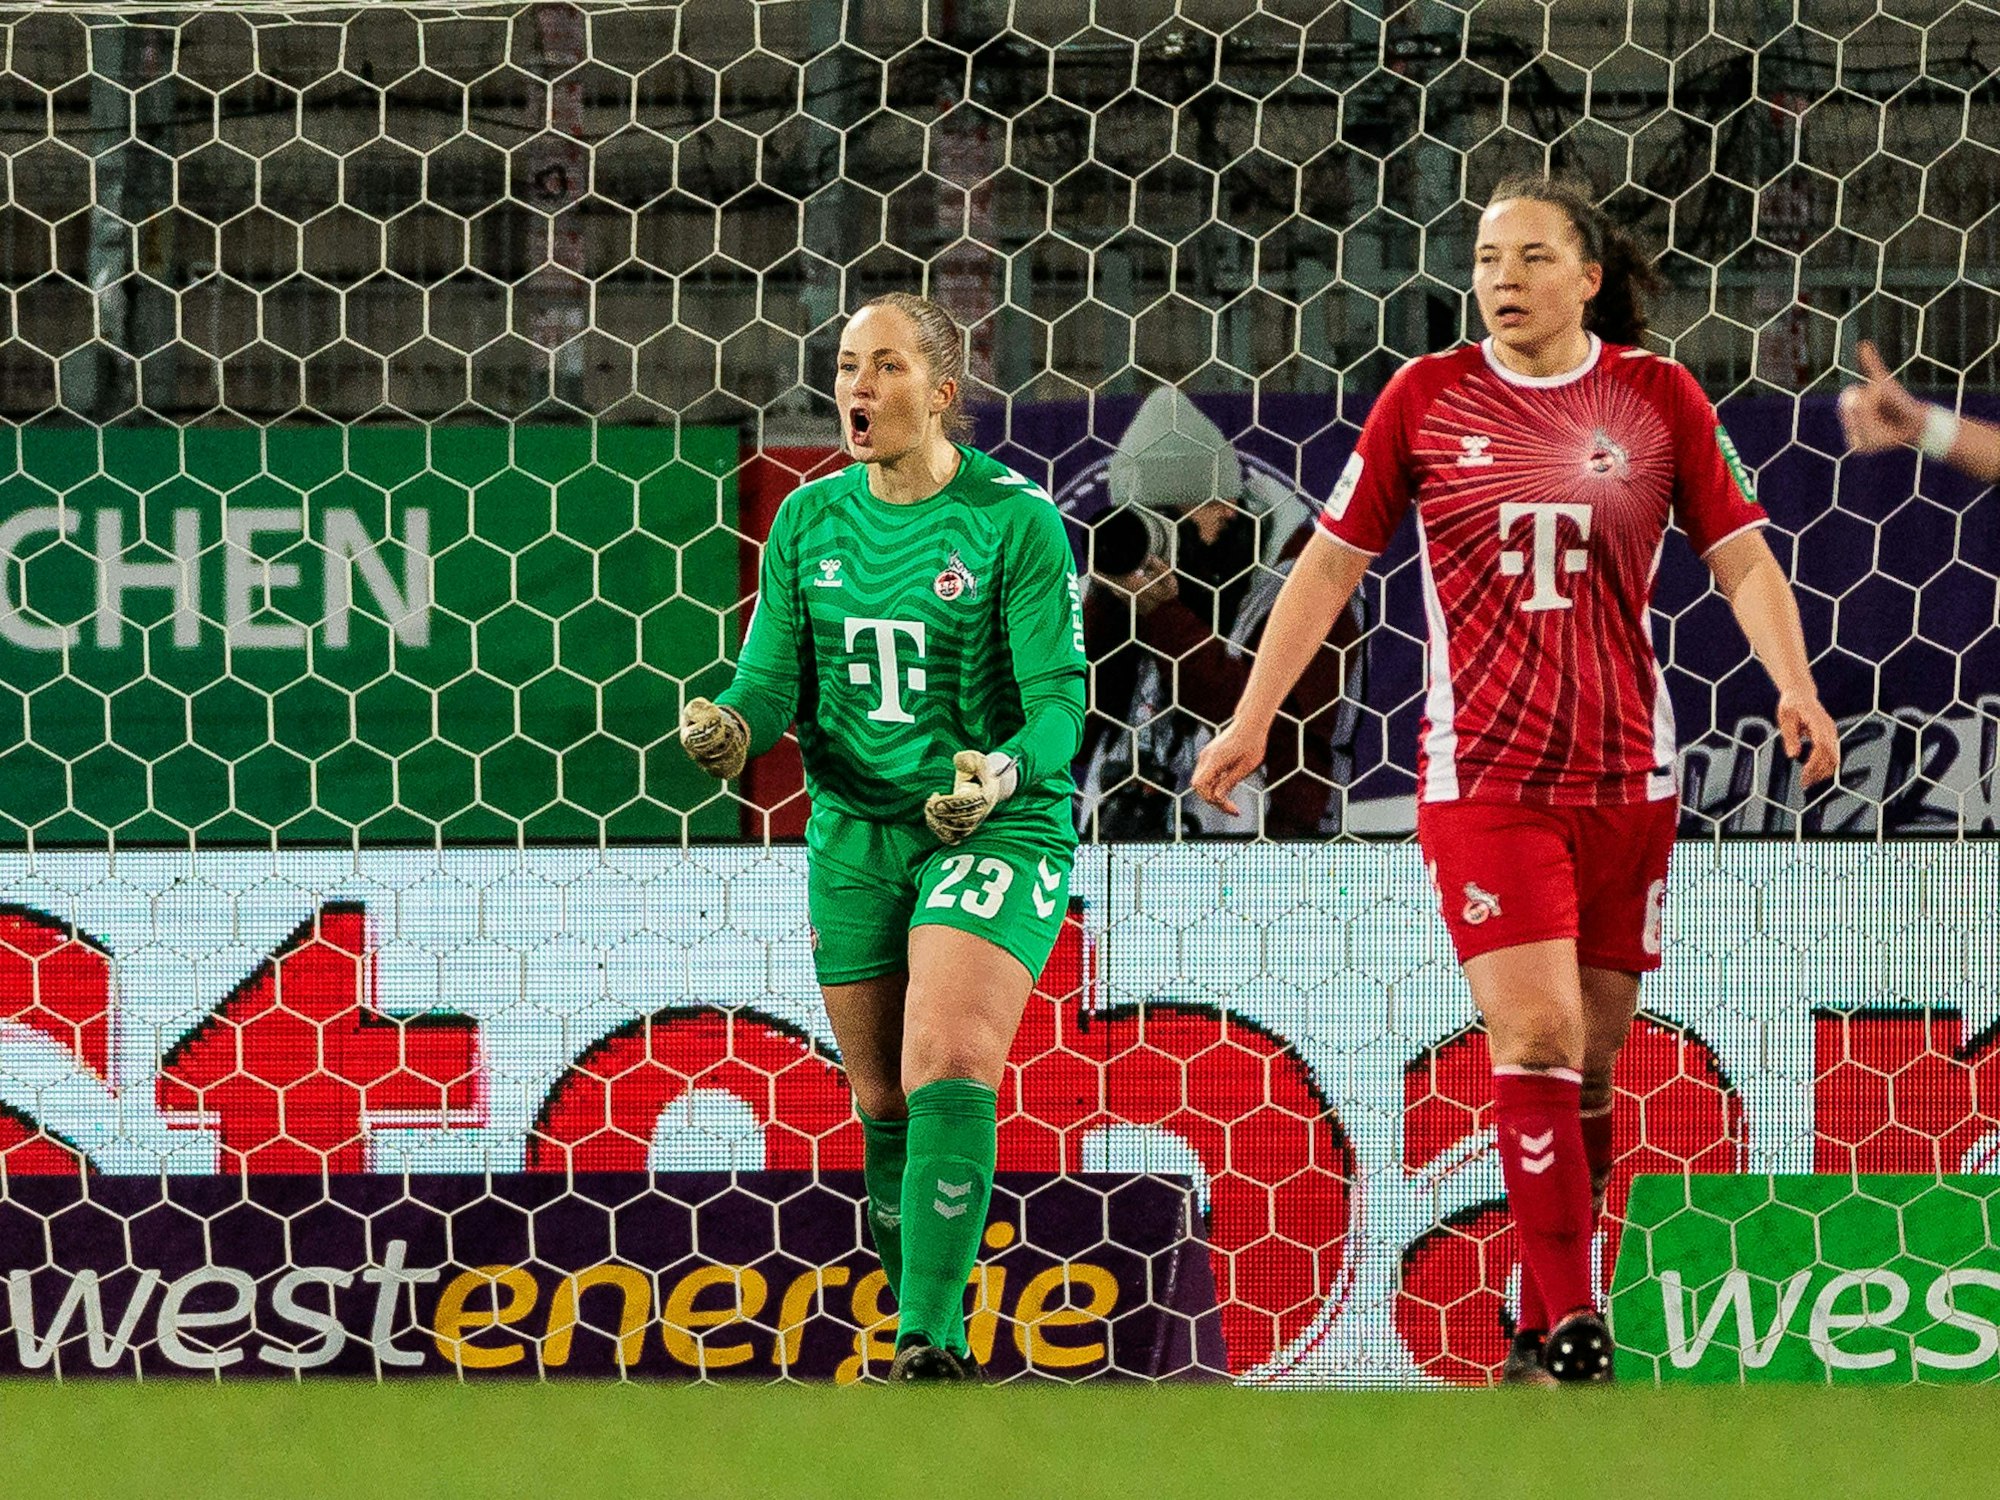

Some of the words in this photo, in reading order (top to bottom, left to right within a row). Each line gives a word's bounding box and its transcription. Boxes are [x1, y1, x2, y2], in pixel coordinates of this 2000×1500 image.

[0, 506, 431, 650] CHEN
[1499, 502, 1592, 612] T
[843, 616, 927, 724] T
[924, 854, 1014, 919] 23
[1660, 1266, 2000, 1370] wes
